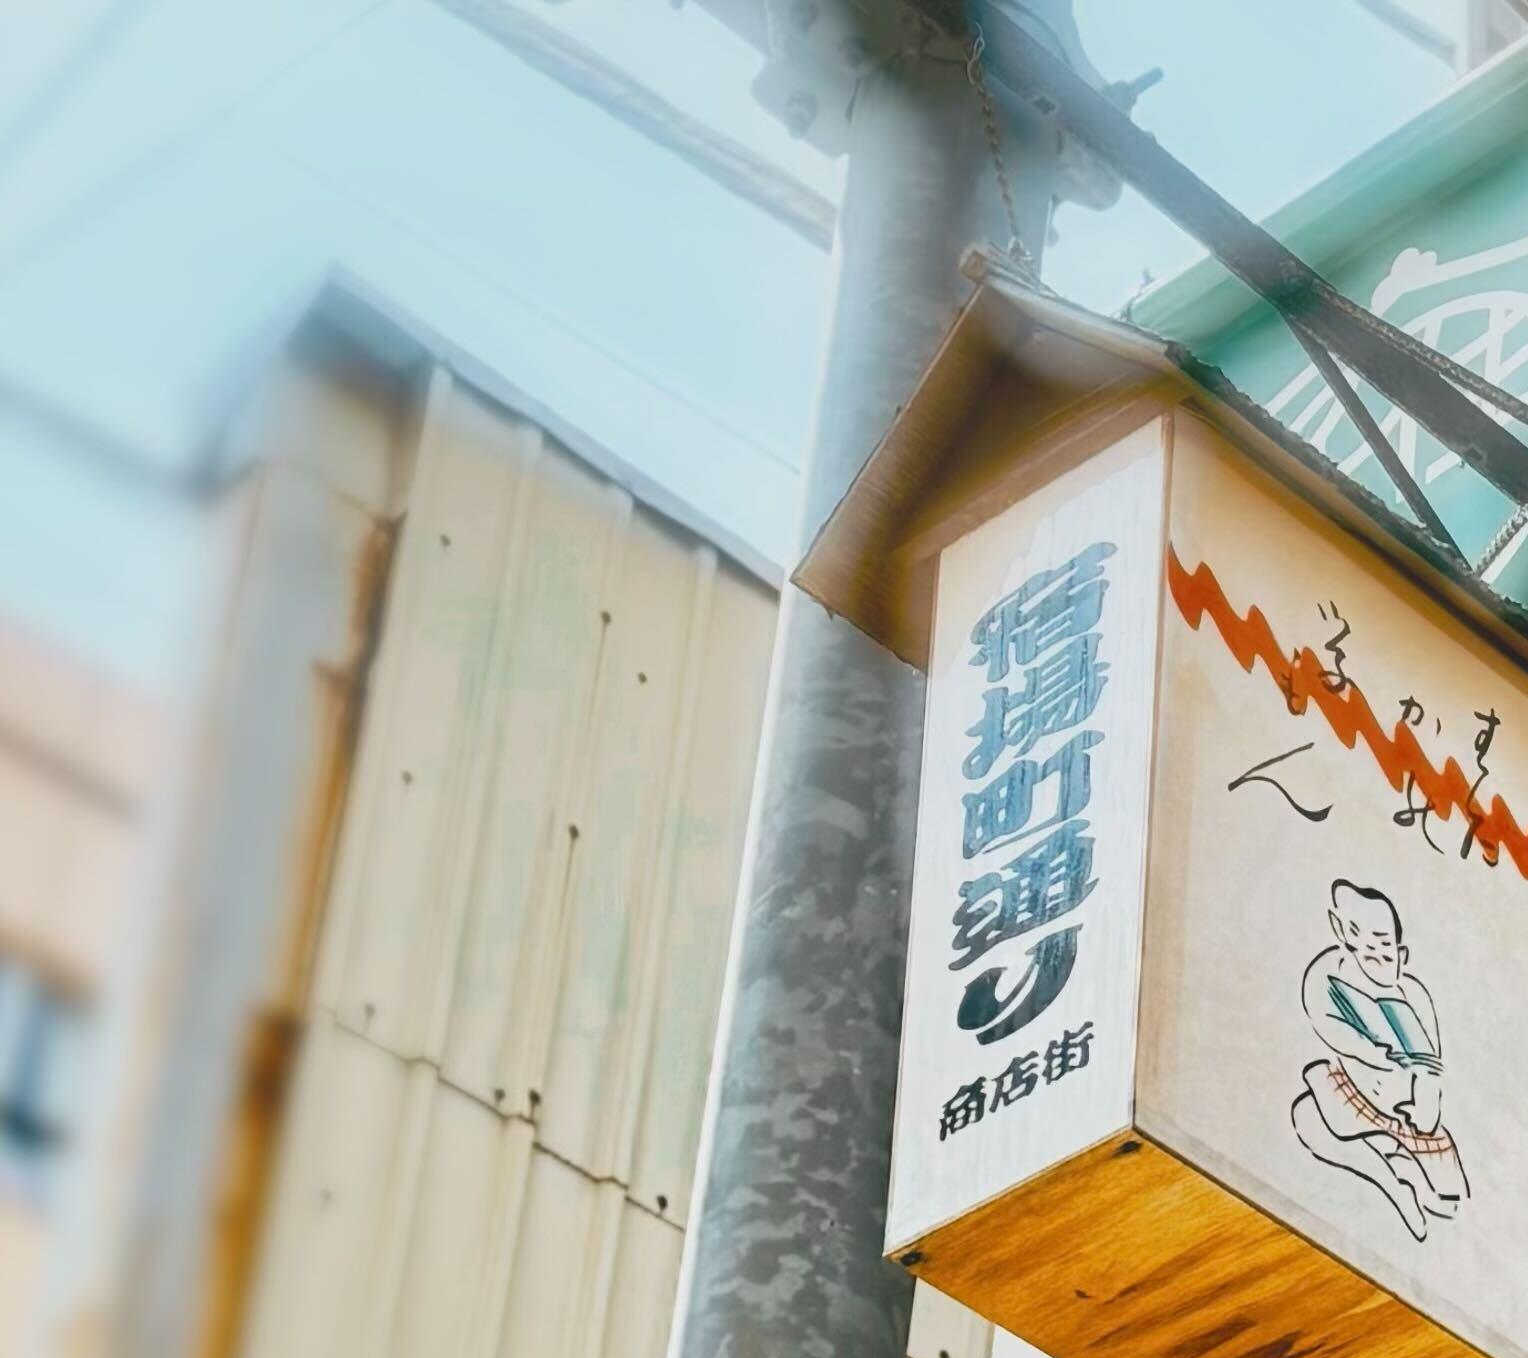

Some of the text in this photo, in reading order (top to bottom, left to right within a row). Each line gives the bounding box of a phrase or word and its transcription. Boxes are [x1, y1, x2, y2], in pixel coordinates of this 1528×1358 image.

[947, 541, 1119, 1047] 宿場町通り
[938, 1021, 1095, 1142] 商店街
